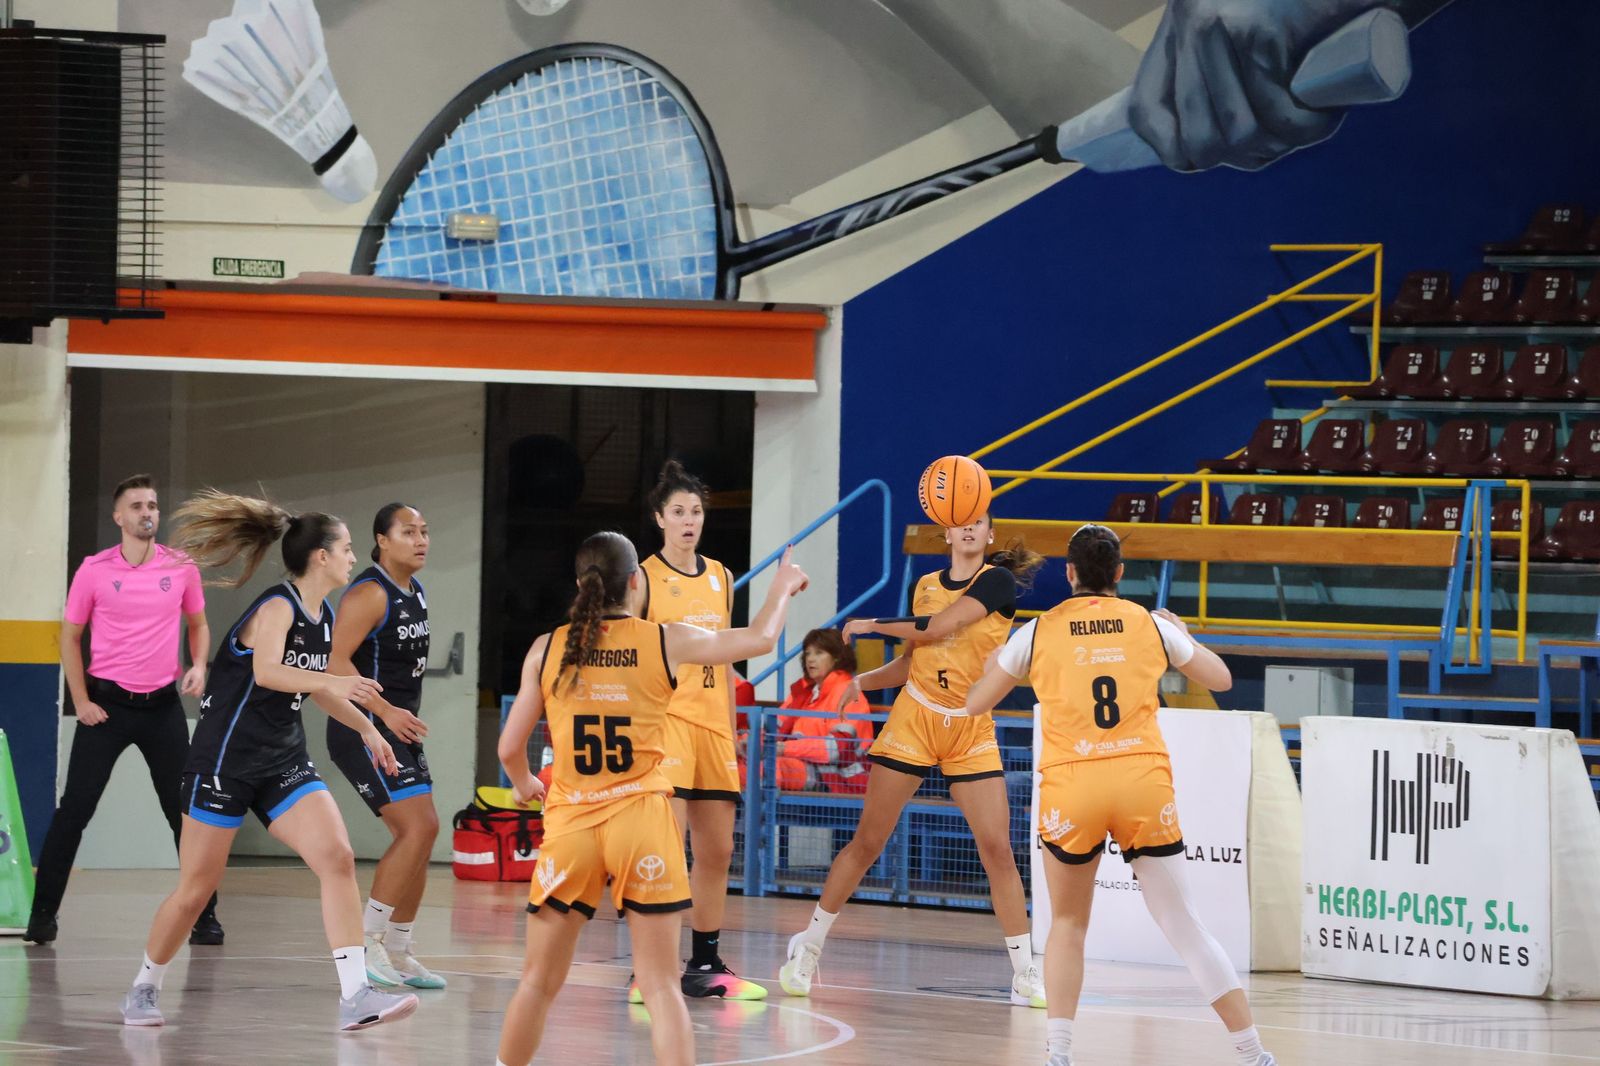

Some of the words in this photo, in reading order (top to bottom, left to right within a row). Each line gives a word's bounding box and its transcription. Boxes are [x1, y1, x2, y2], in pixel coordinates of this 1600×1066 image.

[216, 258, 239, 275] SALIDA
[241, 260, 282, 277] EMERGENCIA
[1534, 352, 1550, 365] 74
[1333, 426, 1348, 439] 76
[1396, 426, 1413, 441] 74
[1459, 427, 1474, 441] 72
[1524, 427, 1539, 441] 70
[1251, 501, 1267, 515] 74
[1314, 503, 1330, 517] 72
[1377, 505, 1394, 519] 70
[1578, 510, 1595, 523] 64
[1070, 618, 1124, 636] RELANCIO
[937, 669, 949, 689] 5
[1091, 675, 1121, 730] 8
[573, 714, 634, 776] 55
[1184, 844, 1205, 862] LA
[1210, 846, 1243, 864] LUZ
[1318, 884, 1474, 935] HERBI-PLAST,
[1484, 899, 1530, 934] S.L.
[1319, 926, 1530, 967] SEÑALIZACIONES
